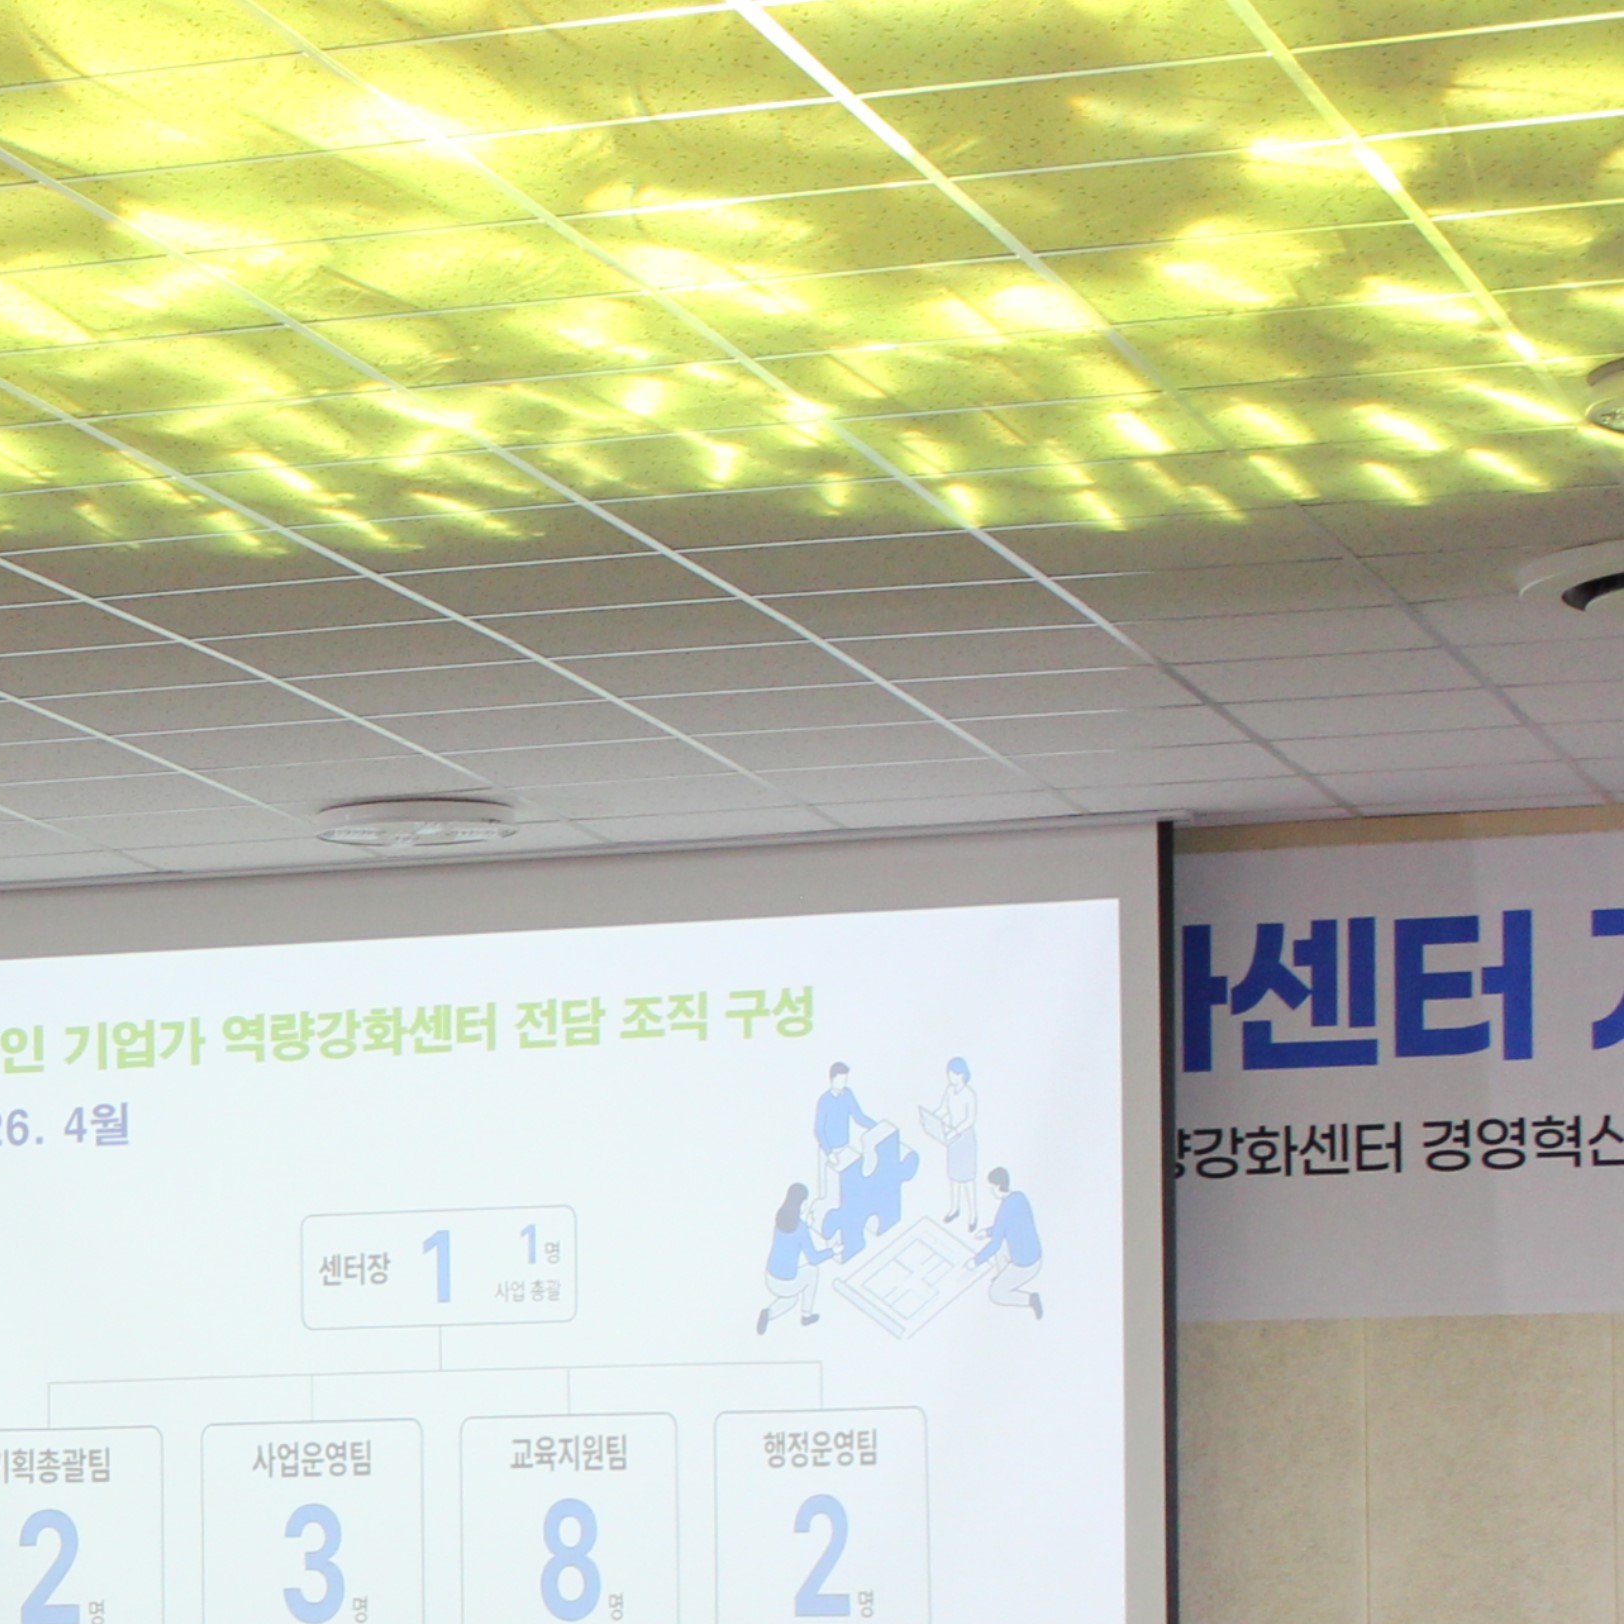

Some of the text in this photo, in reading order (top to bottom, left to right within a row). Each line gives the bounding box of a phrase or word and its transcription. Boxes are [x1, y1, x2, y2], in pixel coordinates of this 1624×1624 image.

[63, 1018, 207, 1071] 기업가
[222, 999, 500, 1064] 역량강화센터
[514, 995, 606, 1050] 전담
[619, 991, 709, 1042] 조직
[724, 985, 815, 1037] 구성
[63, 1102, 130, 1147] 4월
[318, 1229, 452, 1304] 센터장 1
[494, 1280, 526, 1303] 사업
[252, 1440, 372, 1479] 사업운영팀
[509, 1434, 628, 1473] 교육지원팀
[763, 1429, 878, 1469] 행정운영팀
